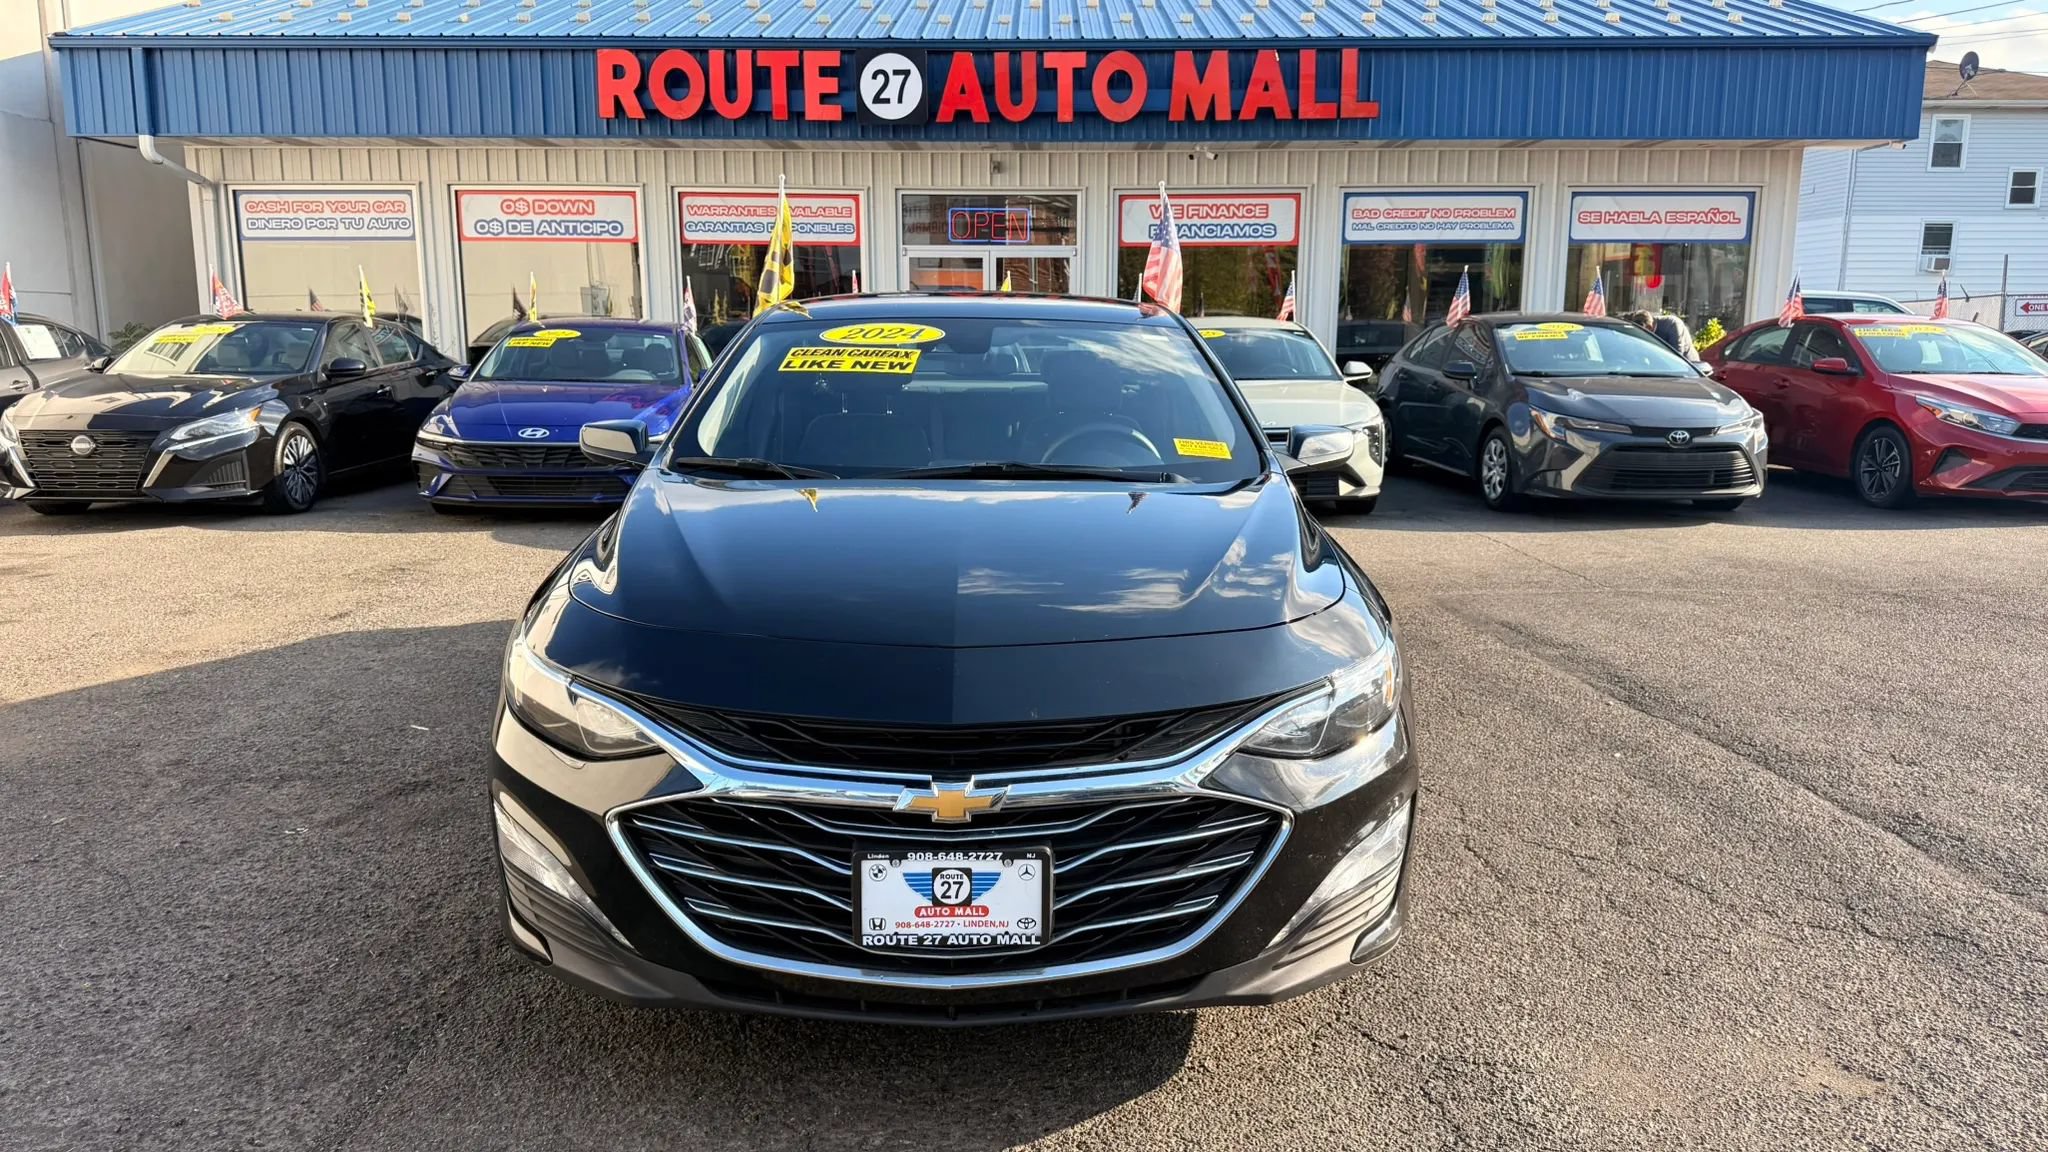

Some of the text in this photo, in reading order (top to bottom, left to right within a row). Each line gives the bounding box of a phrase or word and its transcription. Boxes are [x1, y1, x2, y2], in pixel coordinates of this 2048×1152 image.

[596, 48, 1380, 124] ROUTE 27 AUTO MALL
[245, 200, 406, 213] CASH FOR YOUR CAR
[533, 199, 595, 215] DOWN
[687, 204, 853, 218] WARRANTIES VAILABLE
[1186, 204, 1269, 219] FINANCE
[1352, 208, 1516, 219] BAD CREDIT NO PROBLEM
[1578, 208, 1741, 224] SE HABLA ESPAÑOL
[246, 217, 411, 230] DINERO POR TU AUTO
[506, 219, 535, 235] DE
[537, 220, 624, 236] ANTICIPO
[685, 220, 855, 234] GARANTIAS DPONIBLES
[951, 211, 1028, 240] OPEN
[1351, 221, 1514, 231] MAL CREDITO NO HAY PROBLEMA
[1149, 223, 1276, 239] FANCIAMOS
[2028, 303, 2043, 311] ONE
[840, 327, 926, 340] 2024
[790, 349, 915, 359] CLEAN CARFAX
[782, 359, 913, 371] LIKE NEW
[907, 852, 1003, 862] 908-648-2727
[940, 881, 964, 900] 27
[919, 907, 985, 916] AUTO MALL
[895, 919, 1009, 929] 908-648-2727 LINDEN,NJ
[862, 934, 1041, 946] ROUTE 27 AUTO MALL
